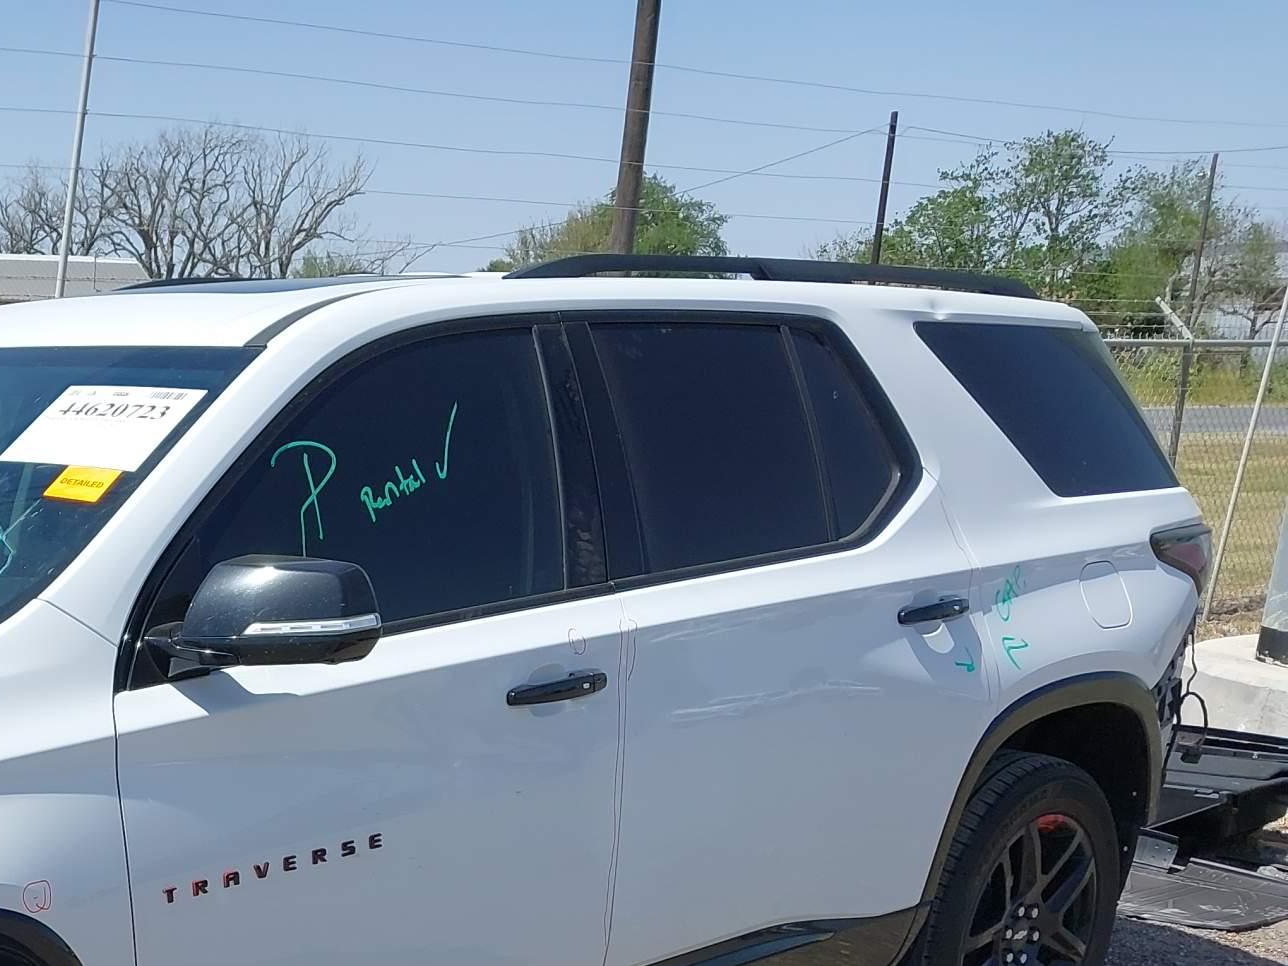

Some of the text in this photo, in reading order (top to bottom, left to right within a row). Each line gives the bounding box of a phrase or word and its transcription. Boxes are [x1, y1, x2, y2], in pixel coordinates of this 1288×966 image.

[58, 401, 171, 420] 44620723
[59, 477, 105, 489] DETAILED
[162, 832, 383, 904] TRAVERSE
